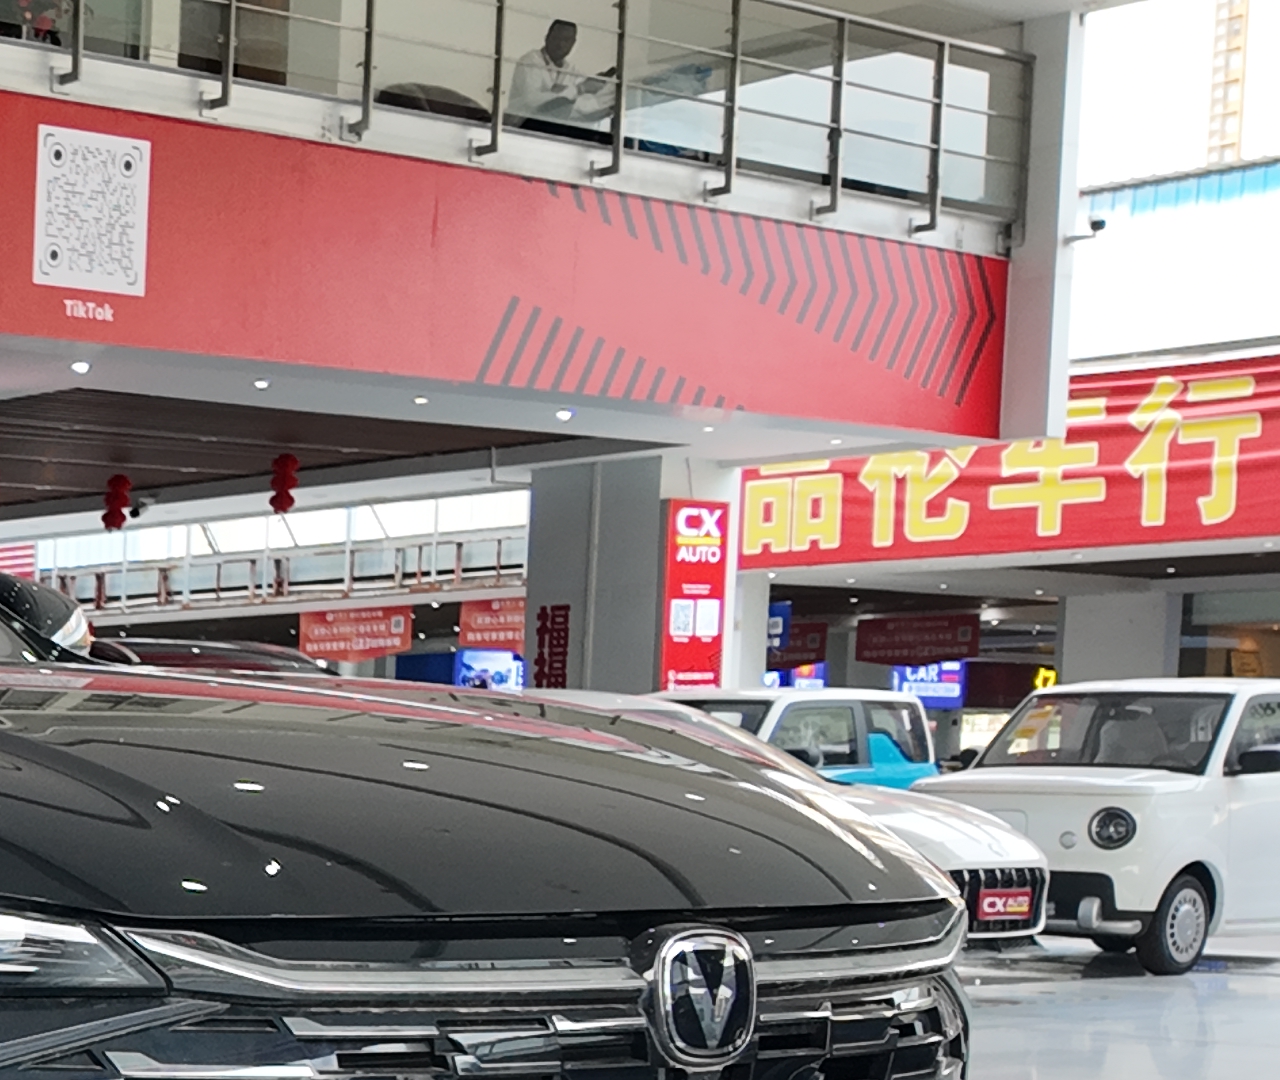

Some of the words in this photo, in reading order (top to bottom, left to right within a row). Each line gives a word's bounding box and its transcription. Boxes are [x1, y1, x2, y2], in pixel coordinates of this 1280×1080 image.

[62, 299, 115, 322] TikTok
[675, 506, 724, 538] CX
[675, 545, 721, 564] AUTO
[982, 896, 1007, 913] CX
